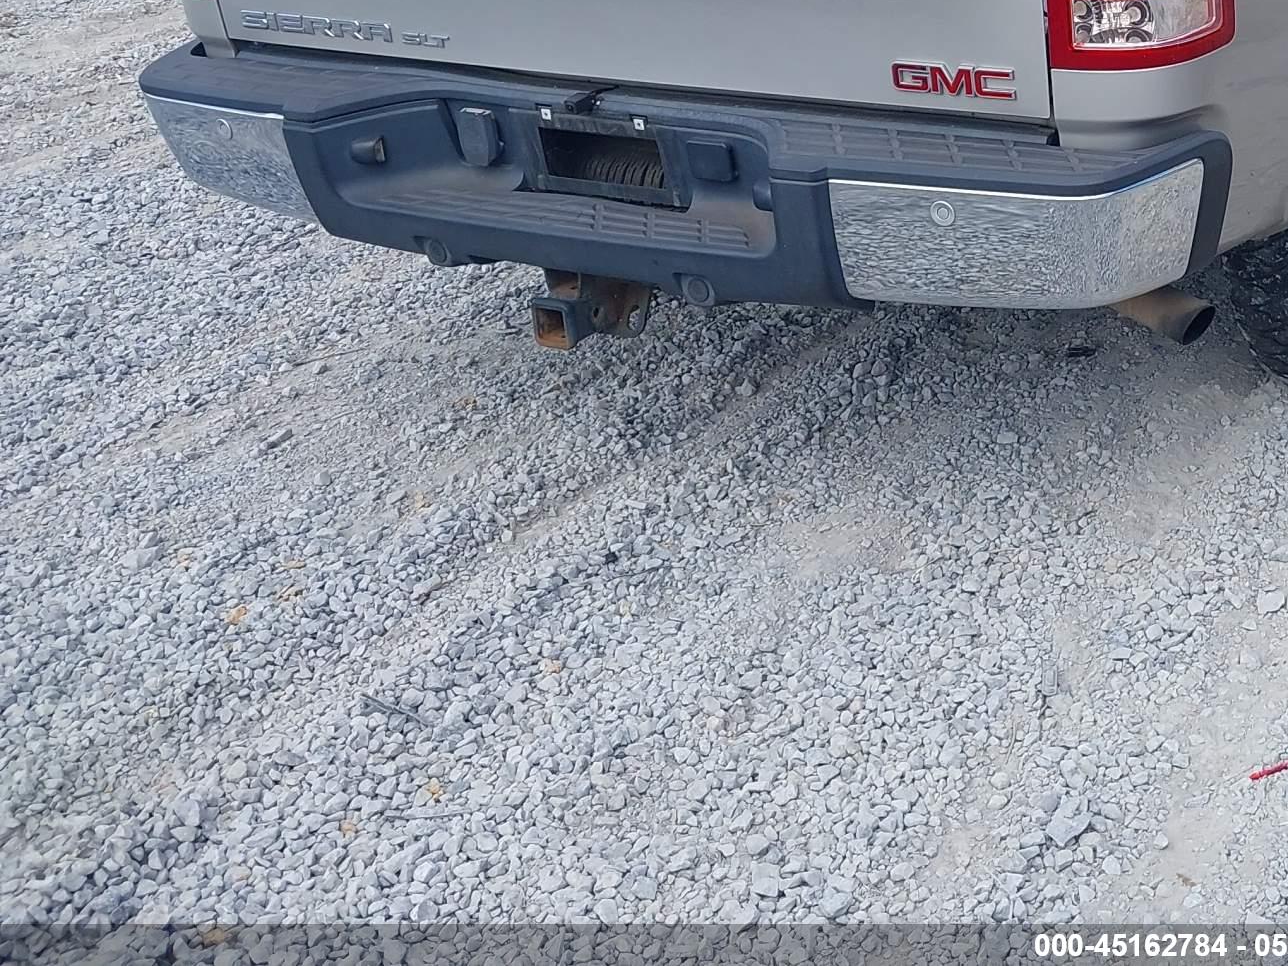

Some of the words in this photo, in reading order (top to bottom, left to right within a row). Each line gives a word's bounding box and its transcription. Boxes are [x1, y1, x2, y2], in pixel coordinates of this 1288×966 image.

[240, 9, 394, 43] SIERRA
[400, 31, 450, 49] SLT
[890, 58, 1017, 101] GMC
